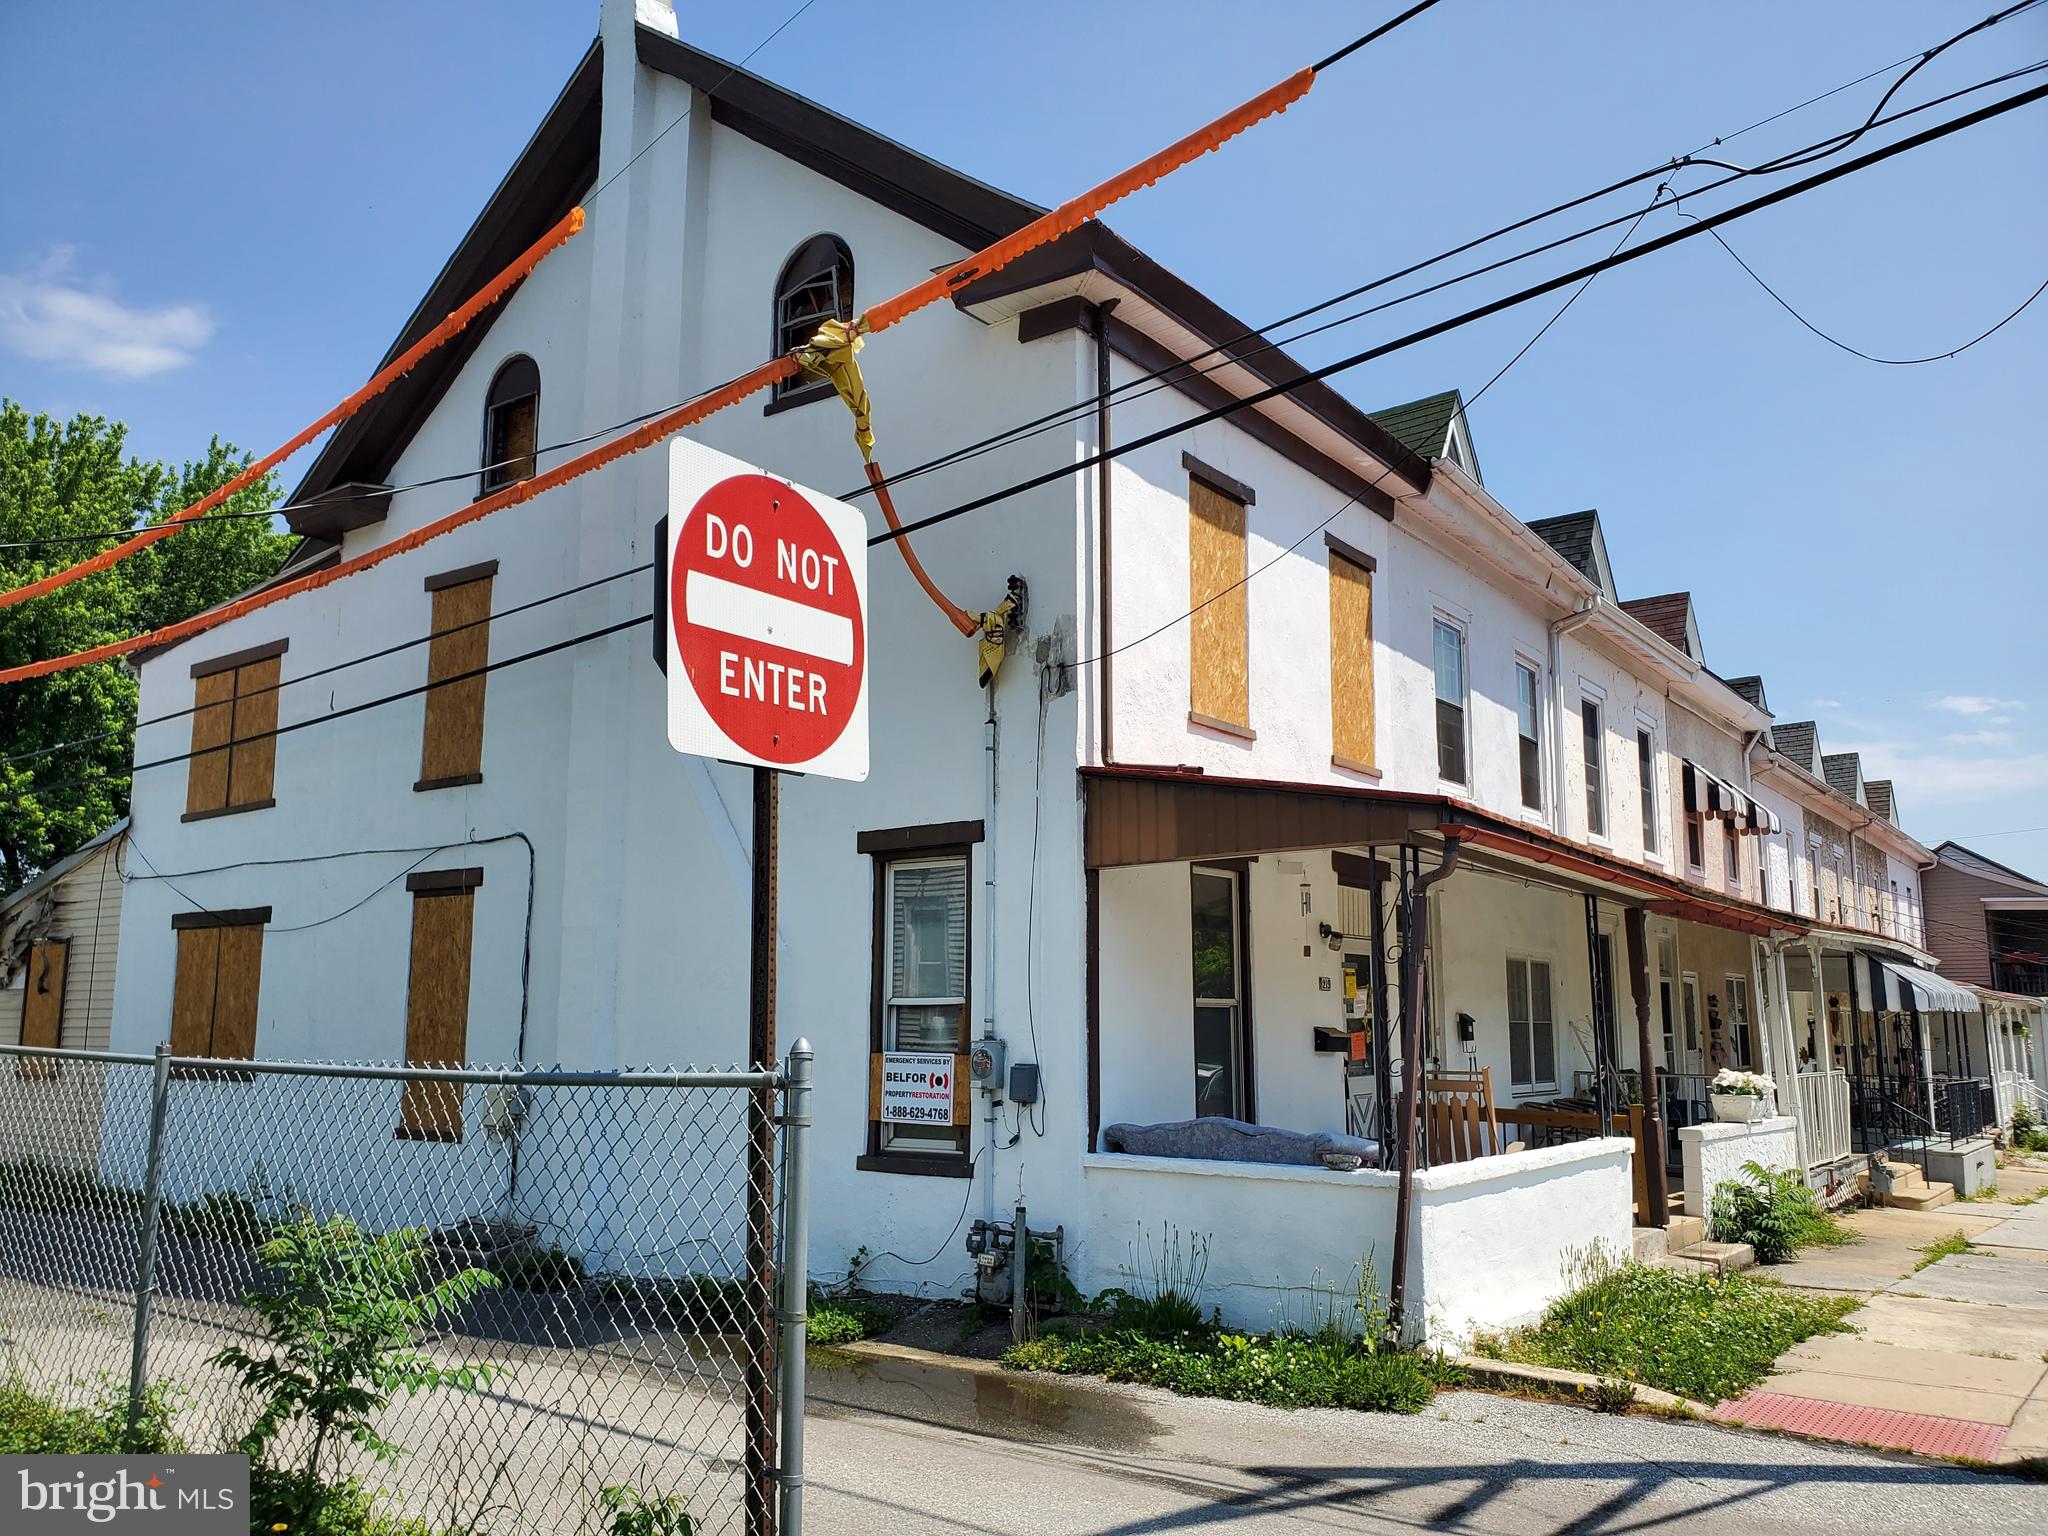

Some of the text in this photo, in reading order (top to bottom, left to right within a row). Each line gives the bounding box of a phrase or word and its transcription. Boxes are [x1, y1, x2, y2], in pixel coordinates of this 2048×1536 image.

[706, 513, 838, 596] DO NOT
[720, 651, 828, 715] ENTER
[886, 1072, 927, 1083] BELFOR
[885, 1105, 949, 1120] 1-888-629-4768
